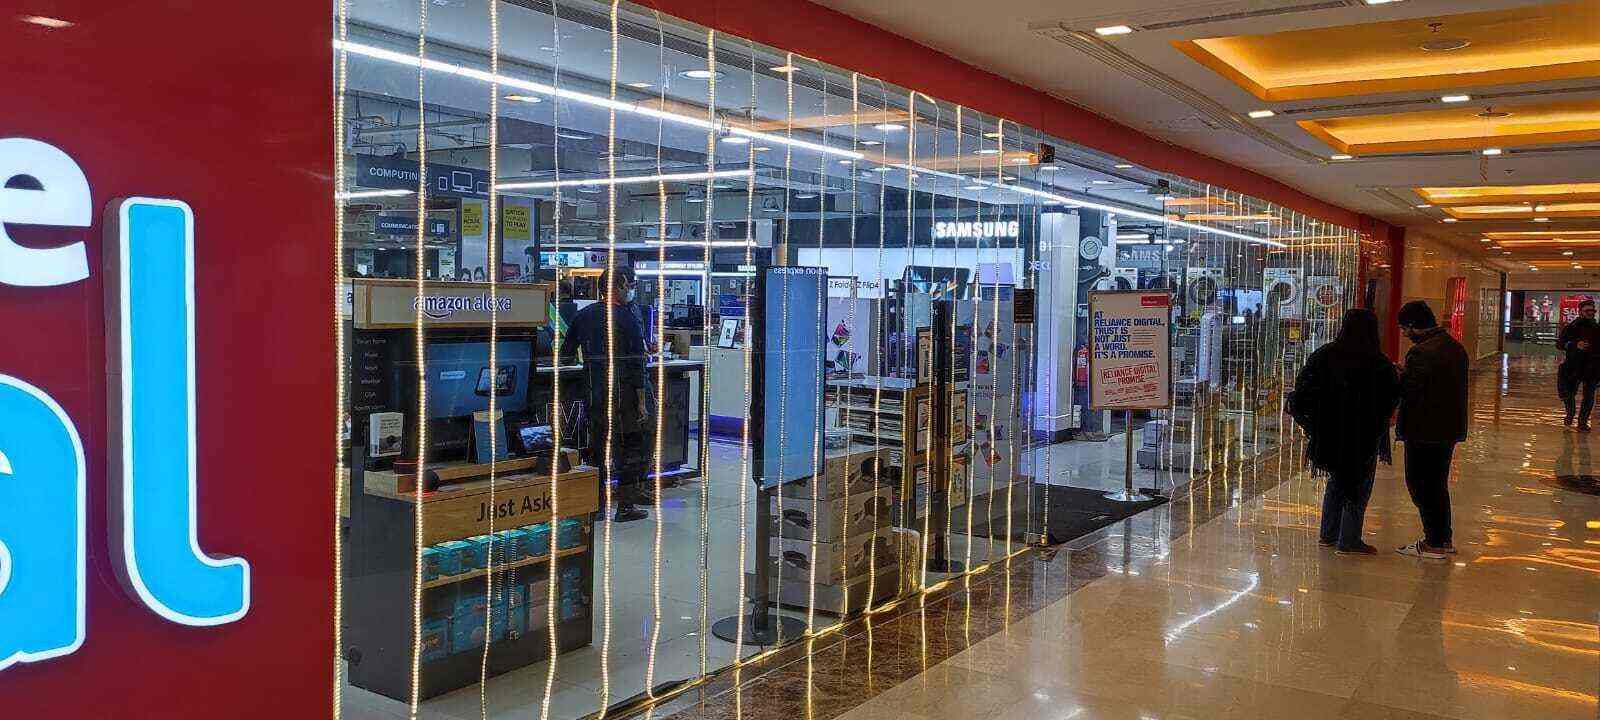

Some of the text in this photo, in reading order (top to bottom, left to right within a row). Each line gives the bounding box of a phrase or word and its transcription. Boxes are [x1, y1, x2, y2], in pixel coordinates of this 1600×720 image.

[370, 167, 419, 181] COMPUTIN
[935, 221, 1019, 238] SAMSUNG
[413, 291, 512, 312] amazon alexa
[1095, 311, 1104, 319] AT
[1095, 318, 1132, 327] RELIANCE
[1095, 326, 1129, 335] TRUST IS
[1095, 334, 1111, 343] NOT
[1112, 334, 1131, 343] JUST
[1104, 367, 1133, 380] RELIANCE
[477, 491, 552, 522] Just Ask
